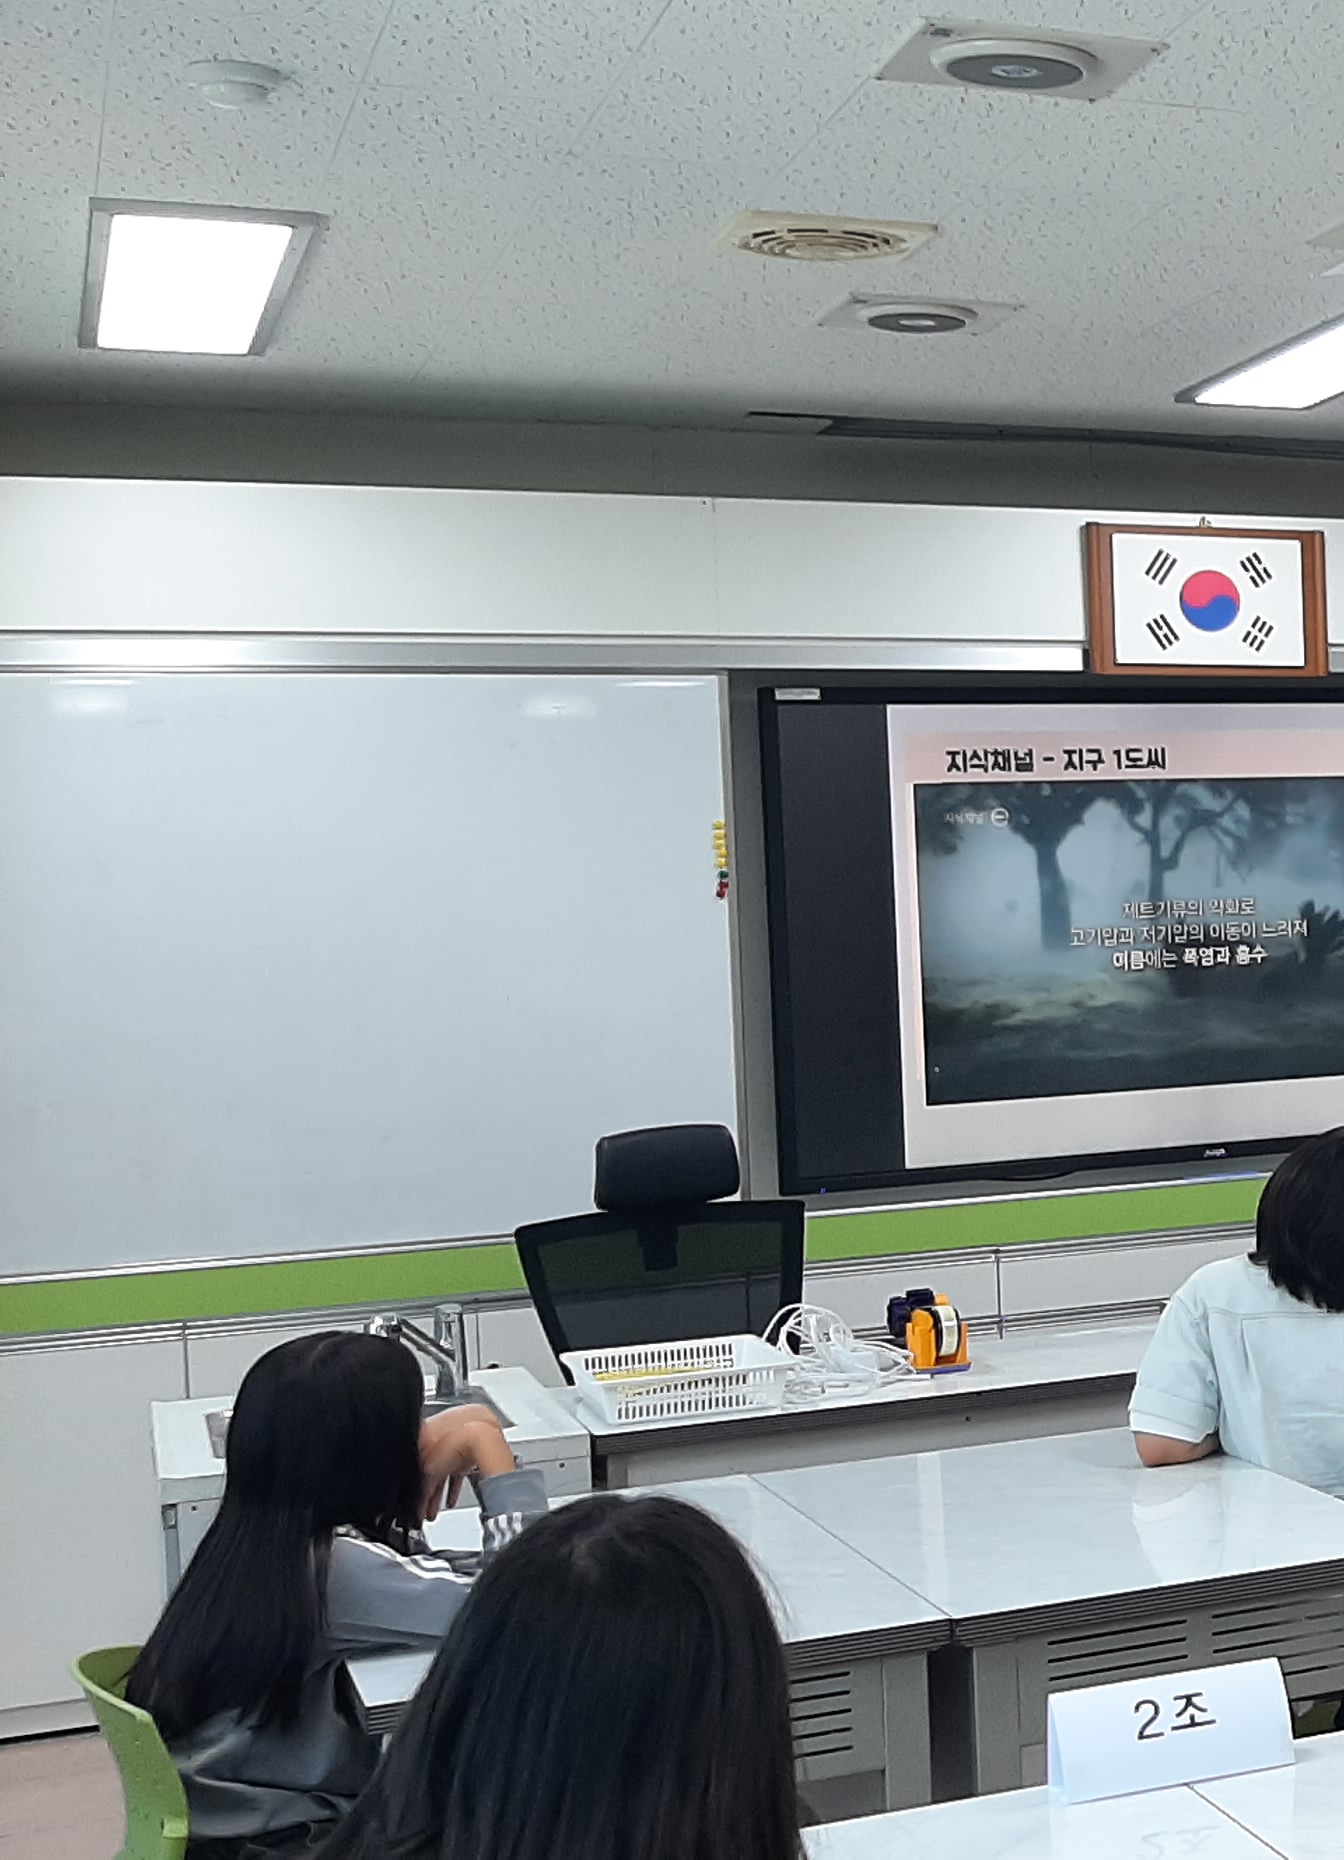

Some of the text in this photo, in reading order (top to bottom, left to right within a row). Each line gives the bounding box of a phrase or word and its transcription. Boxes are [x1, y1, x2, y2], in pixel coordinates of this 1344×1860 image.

[946, 748, 1034, 773] 지식채널
[1063, 747, 1105, 772] 지구
[1113, 746, 1167, 770] 1도씨
[1122, 901, 1203, 919] 제트기류의
[1070, 919, 1309, 947] 고기압과 저기압의 이동이 느려져
[1112, 947, 1178, 971] 여름에는
[1182, 946, 1232, 967] 폭염과
[1133, 1692, 1217, 1741] 2조
